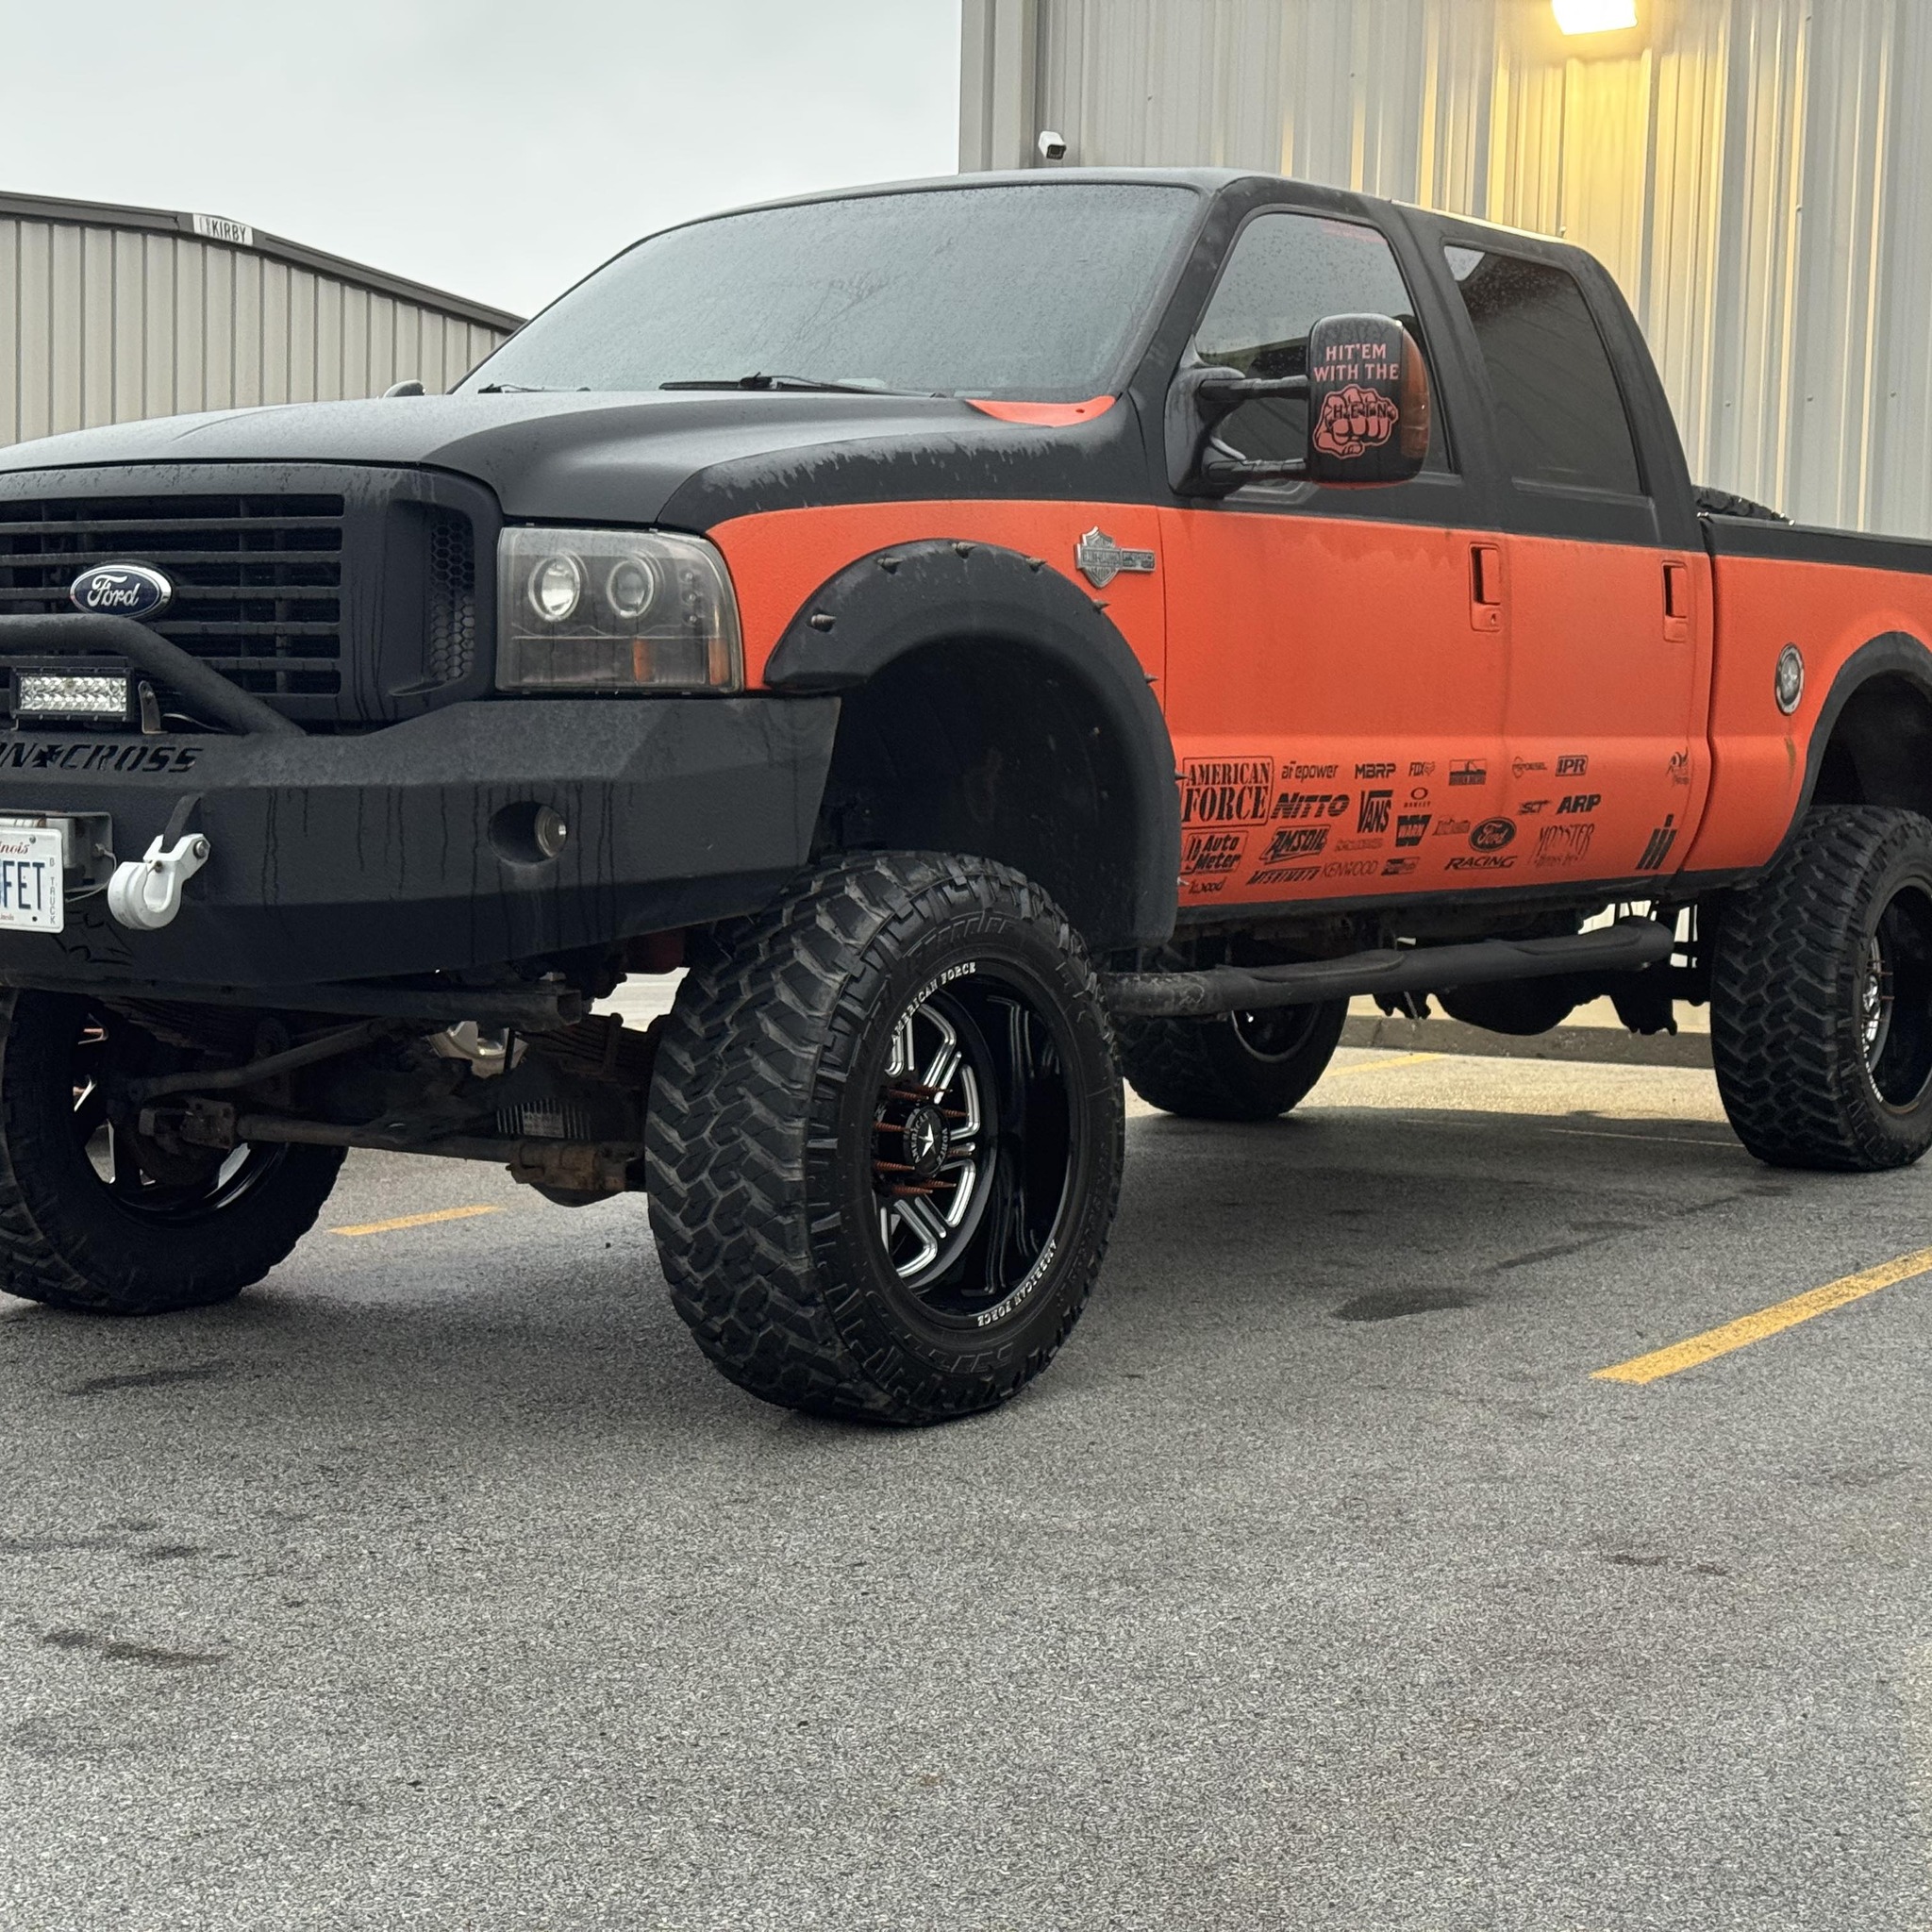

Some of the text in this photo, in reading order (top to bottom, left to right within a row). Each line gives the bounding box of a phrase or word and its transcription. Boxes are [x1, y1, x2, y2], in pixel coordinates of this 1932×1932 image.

[212, 219, 246, 243] KIRBY
[1325, 343, 1387, 361] HIT'EM
[1313, 363, 1400, 382] WITH THE
[87, 574, 142, 608] Ford
[59, 743, 204, 773] CROSS
[1557, 758, 1587, 774] IPR
[1186, 762, 1270, 786] AMERICAN
[1355, 762, 1396, 779] MBRP
[1181, 786, 1269, 822] FORCE
[1271, 792, 1350, 819] NITTO
[1357, 790, 1393, 834] VANS
[1557, 793, 1602, 815] ARP
[1202, 834, 1241, 851] Auto
[1477, 823, 1509, 845] Ford
[1322, 860, 1379, 877] KENWOOD
[1444, 856, 1518, 871] RACING
[891, 961, 976, 1046] AMERICAN FORCE
[977, 1239, 1057, 1327] AMERICAN FORCE
